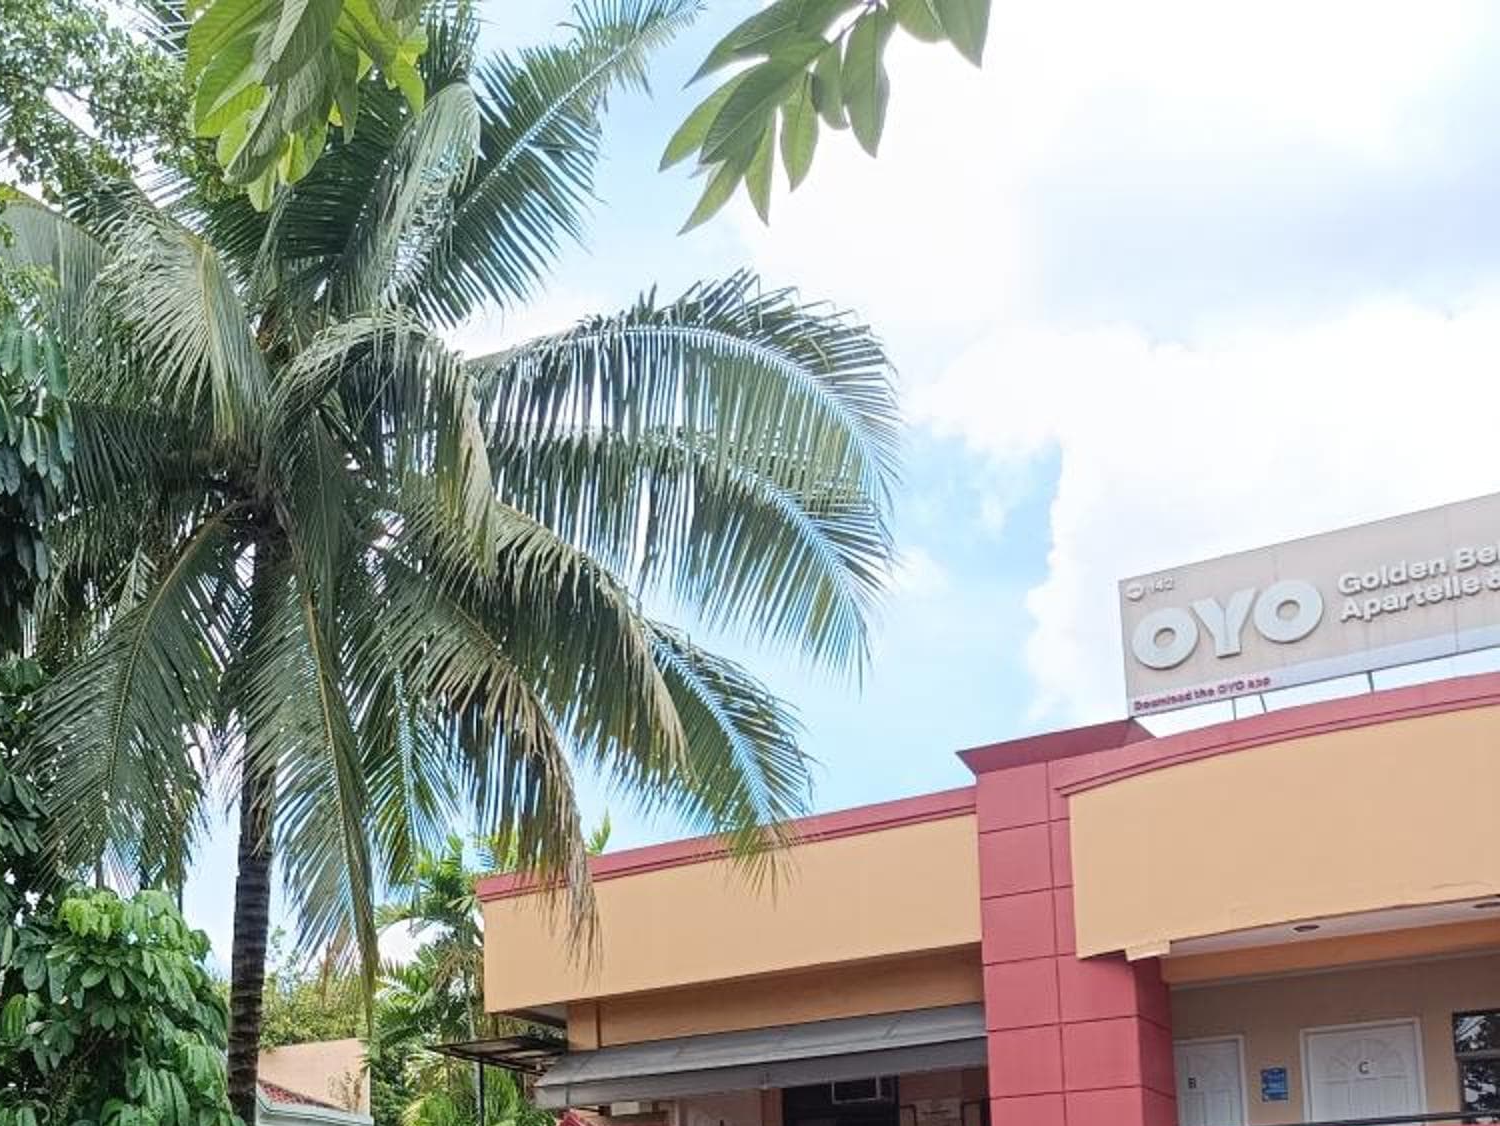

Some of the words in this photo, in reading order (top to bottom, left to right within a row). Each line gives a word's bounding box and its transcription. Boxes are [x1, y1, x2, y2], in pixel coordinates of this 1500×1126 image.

[1338, 557, 1447, 595] Golden
[1340, 575, 1481, 622] Apartelle
[1131, 579, 1324, 670] OYO
[1194, 686, 1215, 698] the
[1217, 680, 1245, 694] OYO
[1358, 1061, 1371, 1075] C
